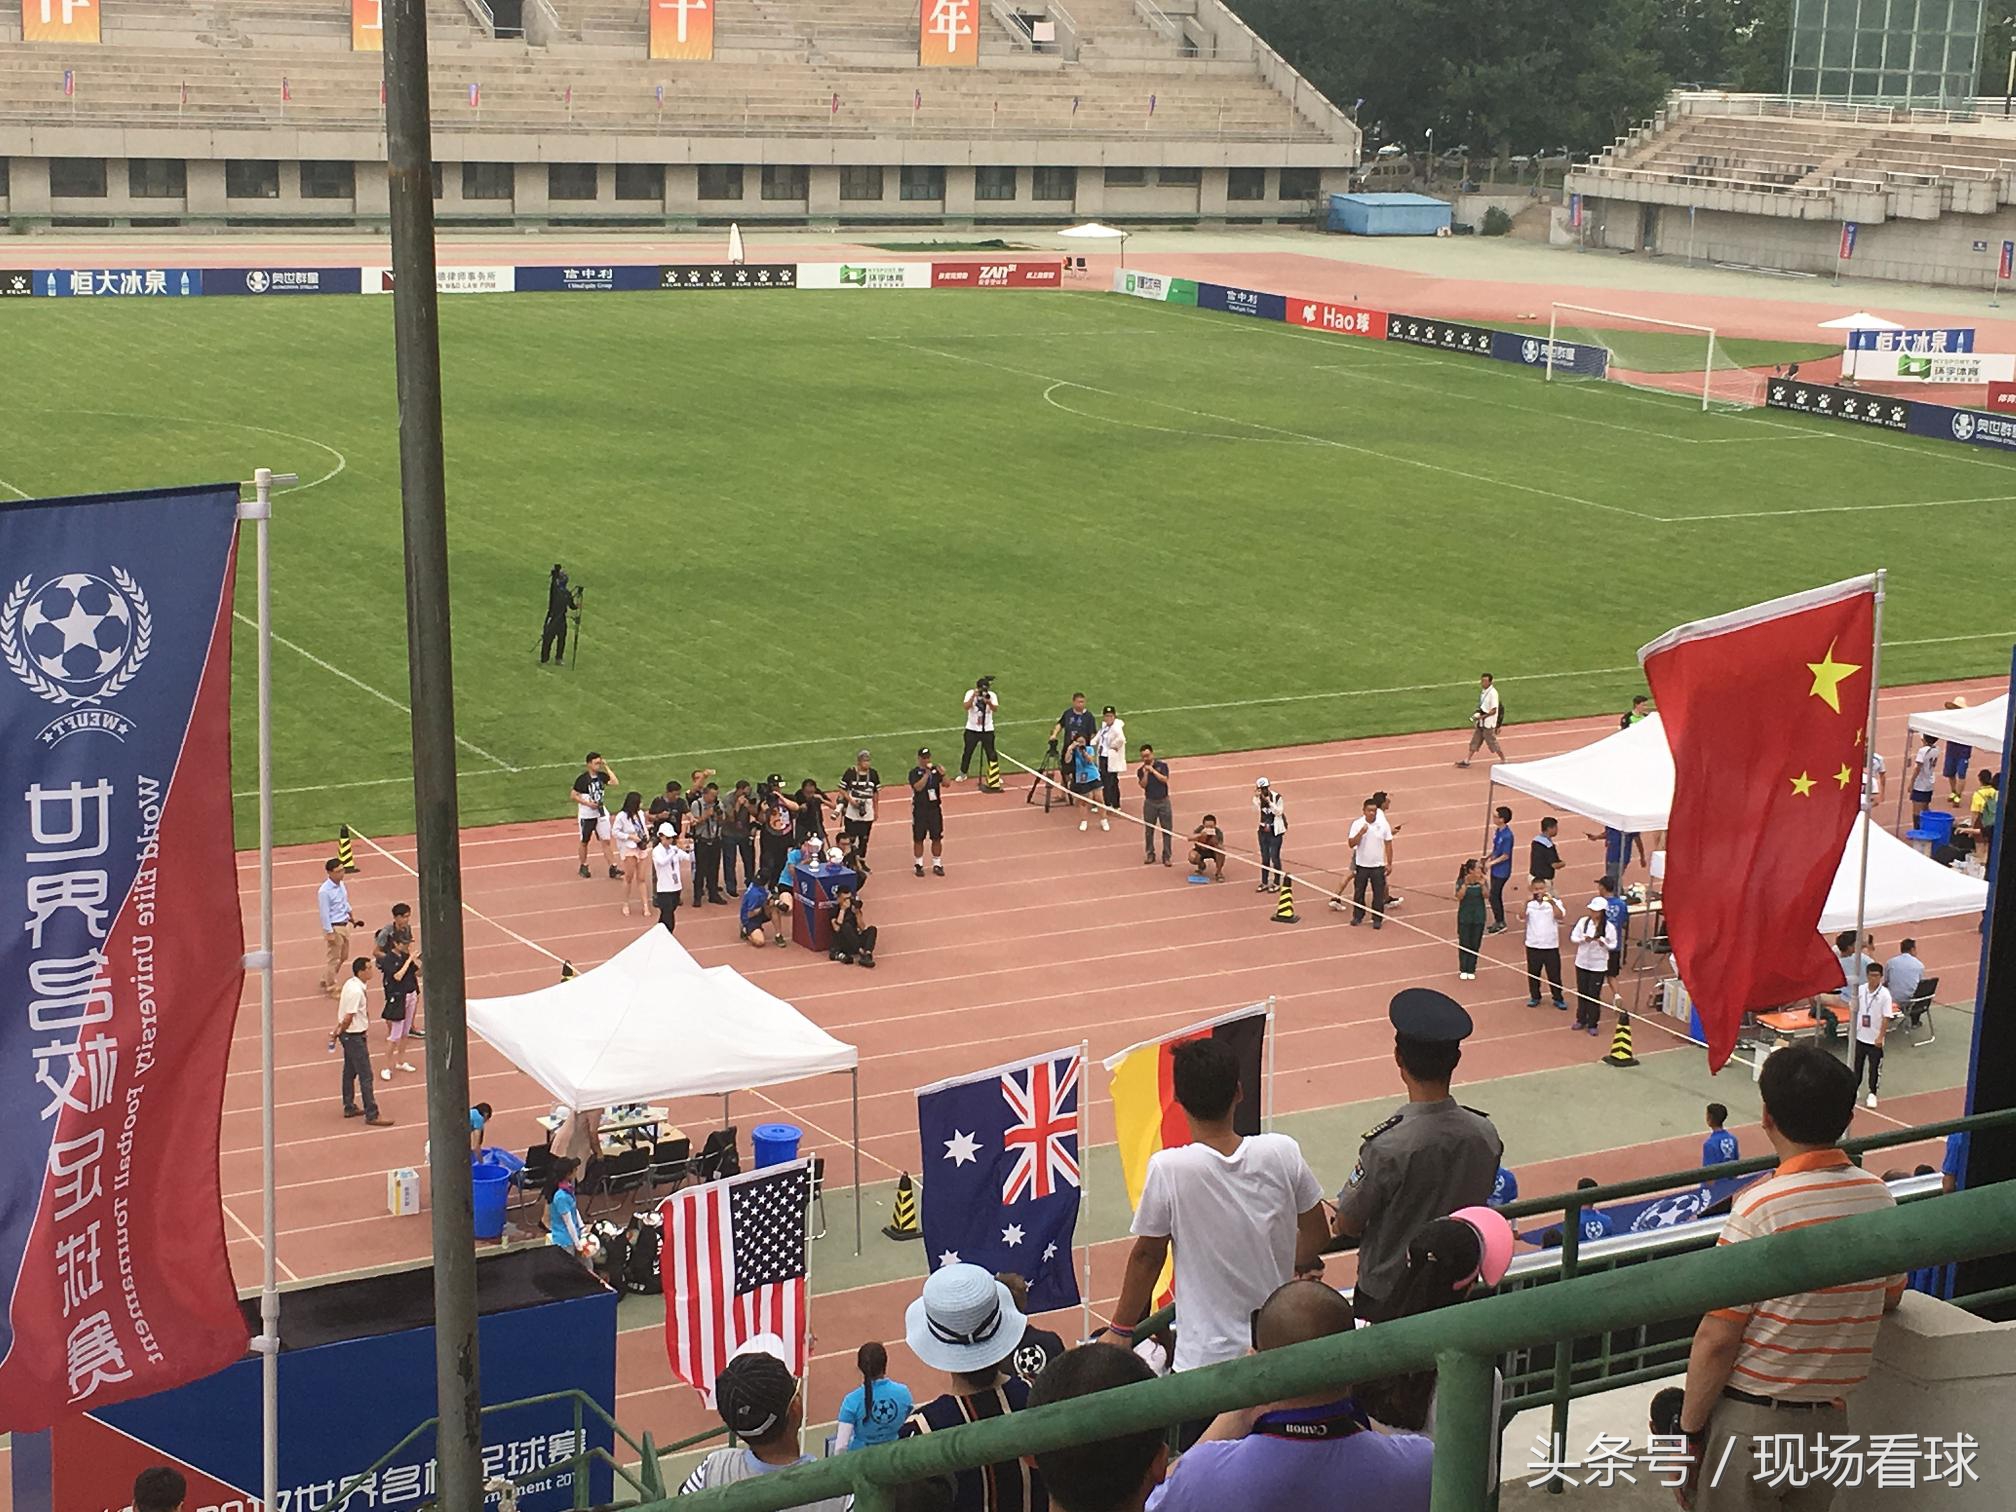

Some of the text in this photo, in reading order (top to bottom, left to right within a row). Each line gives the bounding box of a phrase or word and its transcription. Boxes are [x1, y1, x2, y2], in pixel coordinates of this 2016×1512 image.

[928, 0, 972, 53] 年
[70, 270, 167, 295] 恒大冰泉
[563, 268, 613, 279] 信中利
[1876, 331, 1948, 353] 恒大冰泉
[1286, 1424, 1328, 1436] Canon
